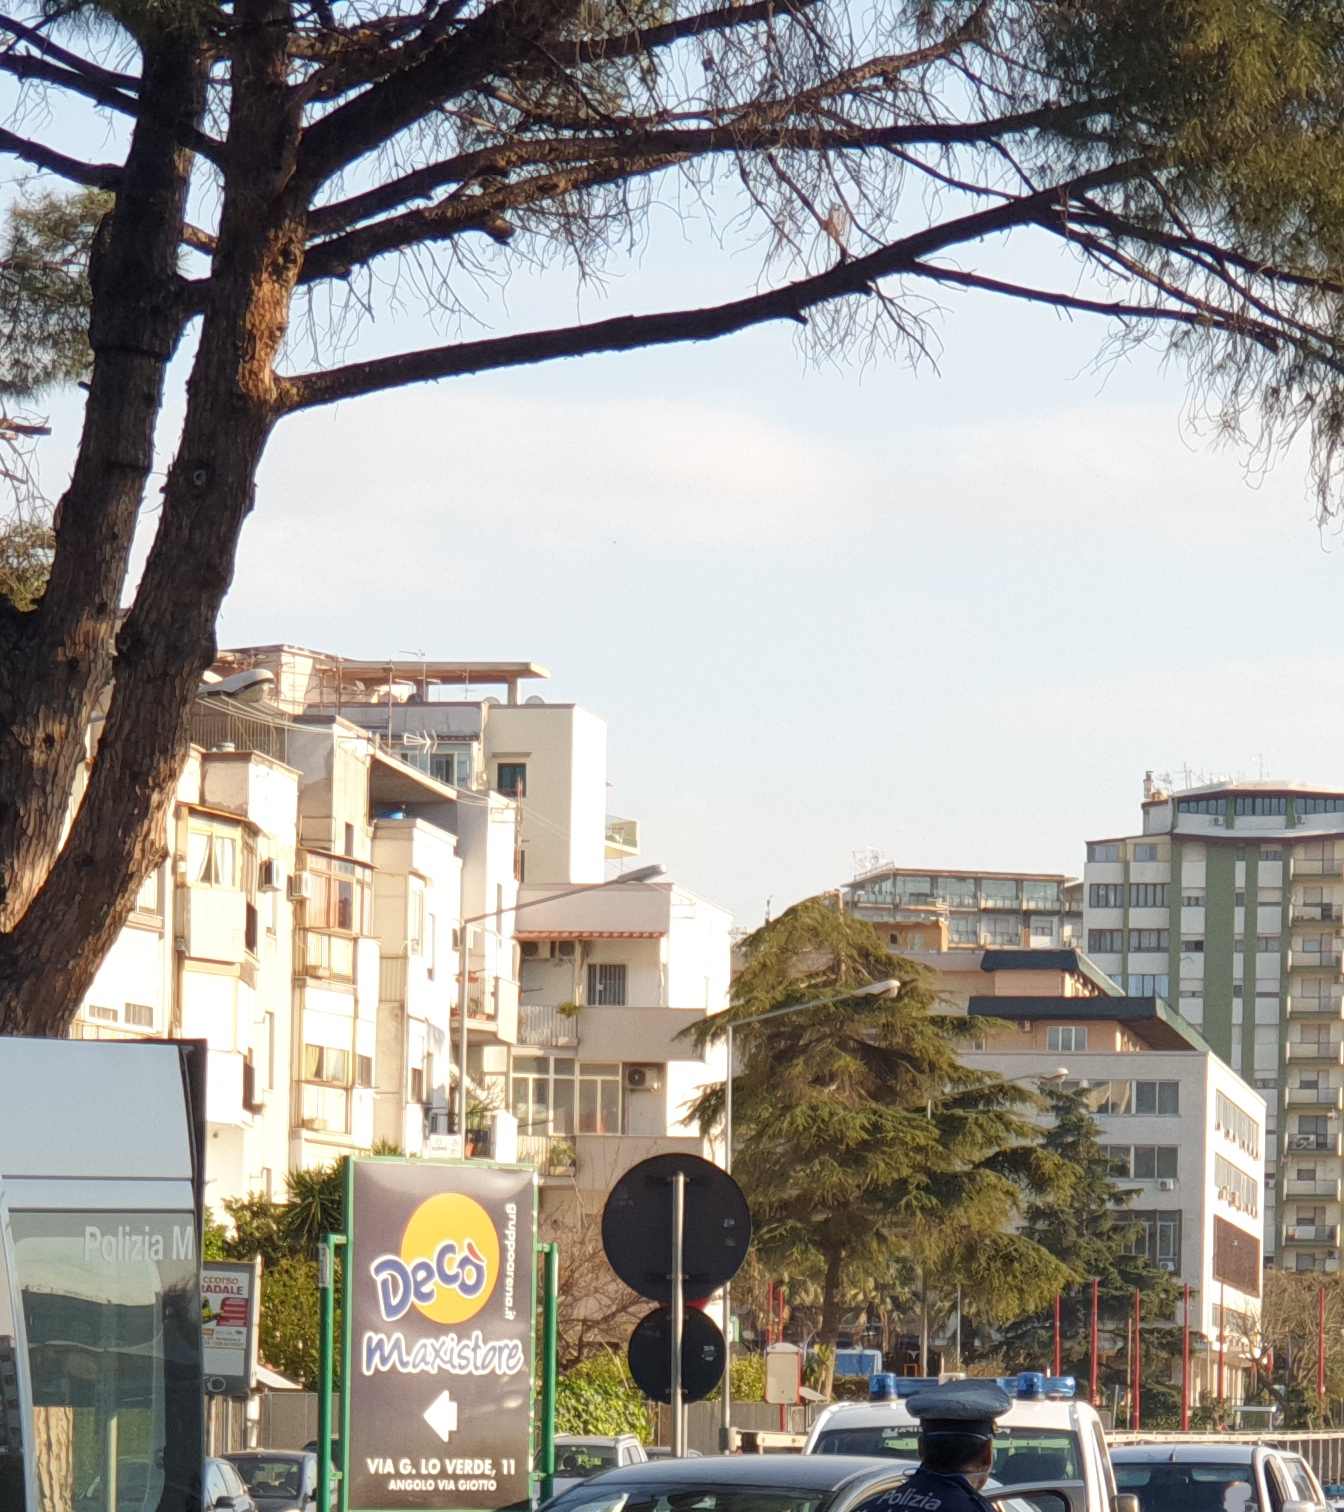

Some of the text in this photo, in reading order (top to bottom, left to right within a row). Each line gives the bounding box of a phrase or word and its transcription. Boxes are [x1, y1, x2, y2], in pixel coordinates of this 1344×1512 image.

[84, 1226, 164, 1261] Polizia
[504, 1202, 517, 1321] gruppoarena.it
[366, 1458, 516, 1478] VIA G. LO VERDE, 11
[388, 1479, 497, 1491] ANGOLO VIA GIOTTO
[877, 1487, 942, 1512] Polizia
